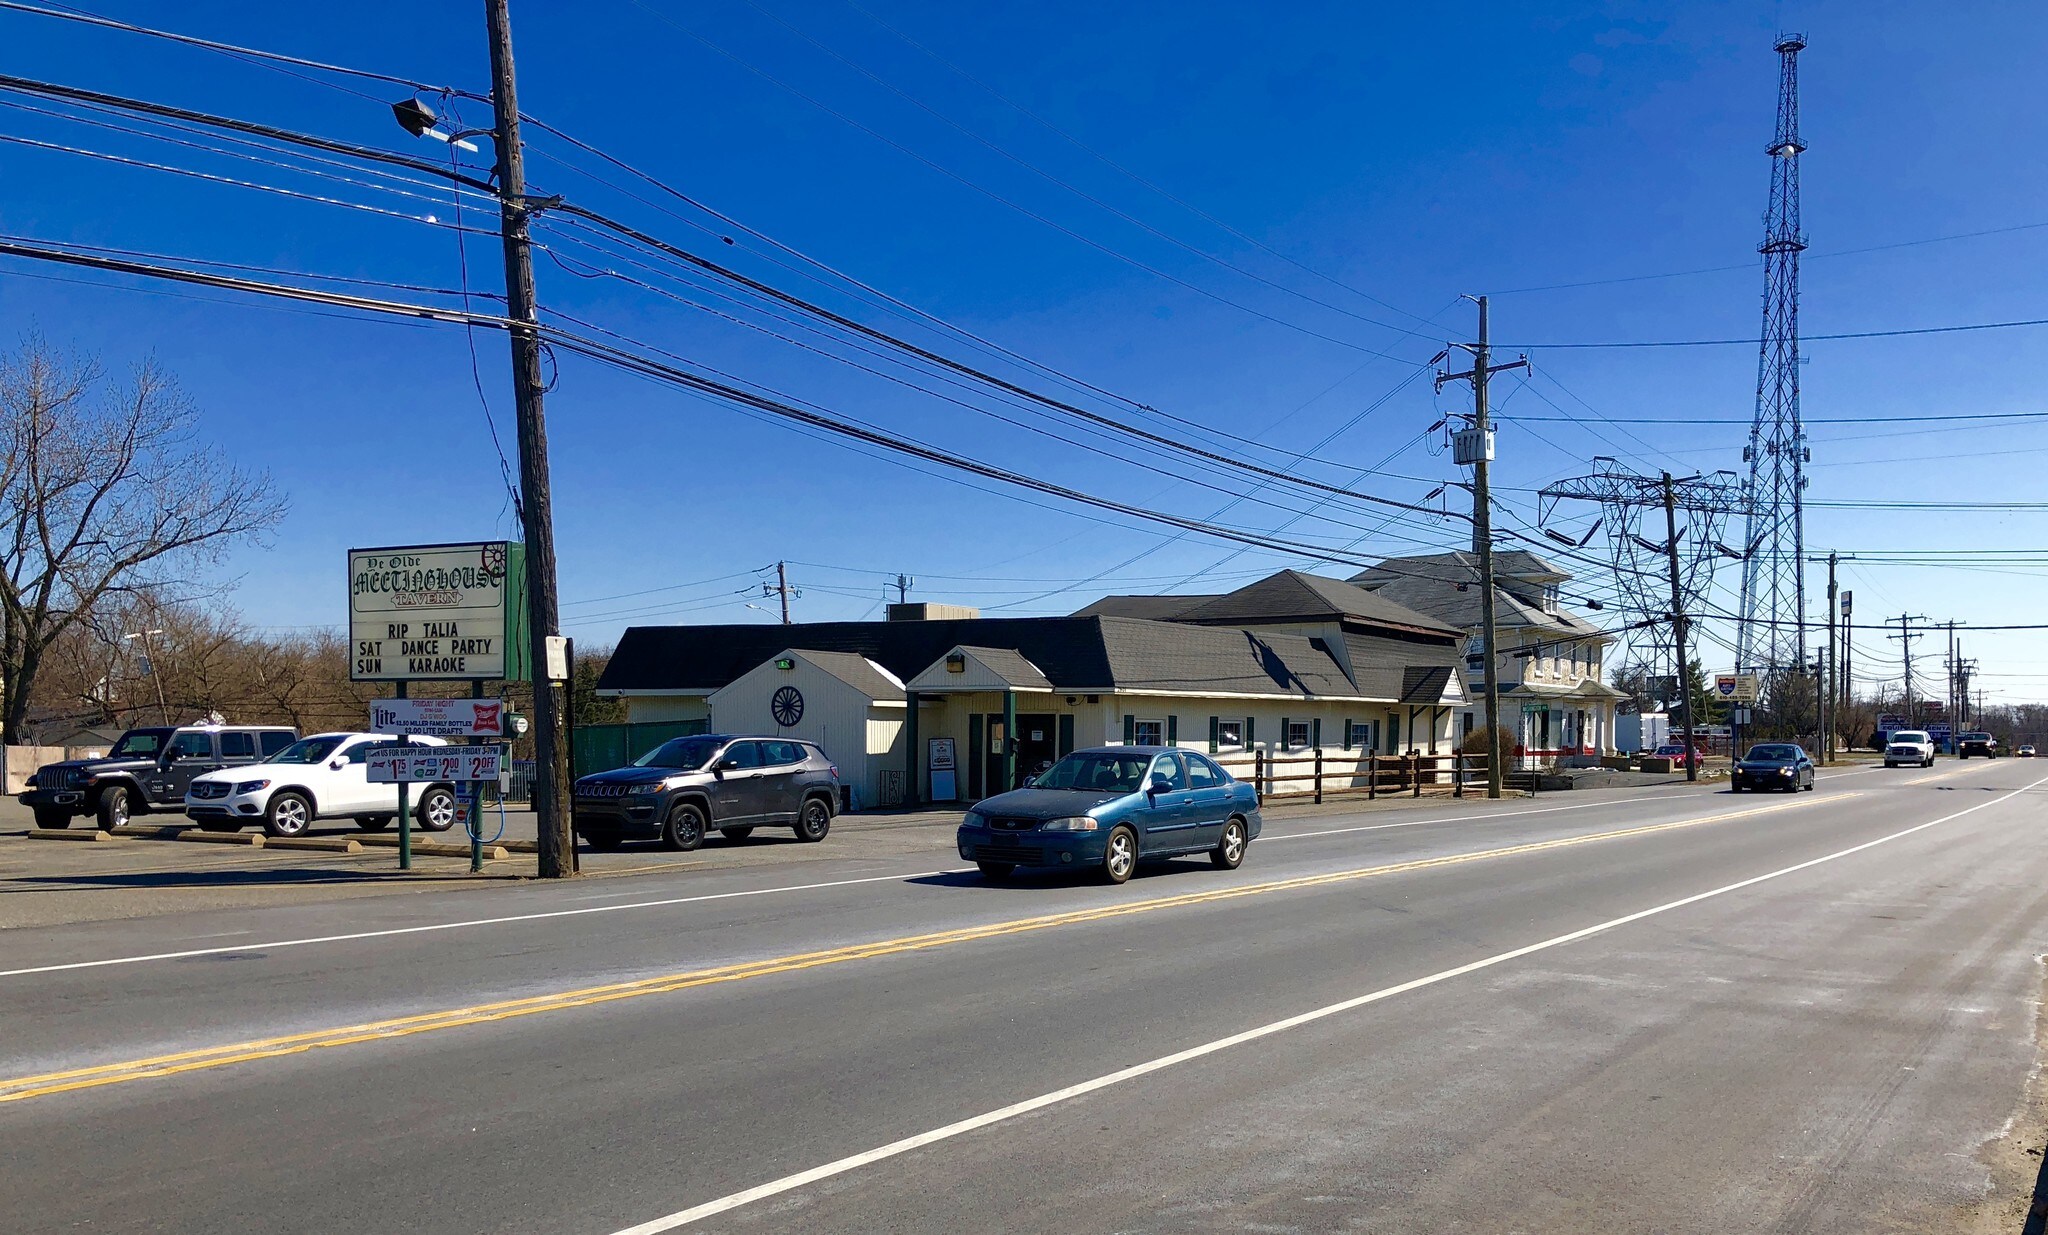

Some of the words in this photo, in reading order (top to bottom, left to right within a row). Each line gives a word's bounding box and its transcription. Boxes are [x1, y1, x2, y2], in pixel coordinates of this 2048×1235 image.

[366, 557, 384, 572] Ye
[390, 556, 421, 568] Olde
[395, 591, 459, 606] TAVERN
[387, 623, 409, 640] RIP
[423, 621, 459, 639] TALIA
[359, 641, 383, 657] SAT
[401, 640, 439, 656] DANCE
[451, 639, 492, 655] PARTY
[357, 658, 382, 674] SUN
[409, 656, 466, 674] KARAOKE
[412, 700, 434, 708] FRIDAY
[435, 700, 455, 708] NIGHT
[405, 727, 422, 735] $2.00
[422, 727, 437, 735] LITE
[437, 727, 464, 735] DRAFTS
[381, 749, 389, 757] US
[389, 748, 400, 757] FOR
[400, 748, 417, 756] HAPPY
[418, 747, 432, 756] HOUR
[481, 756, 496, 769] OFF
